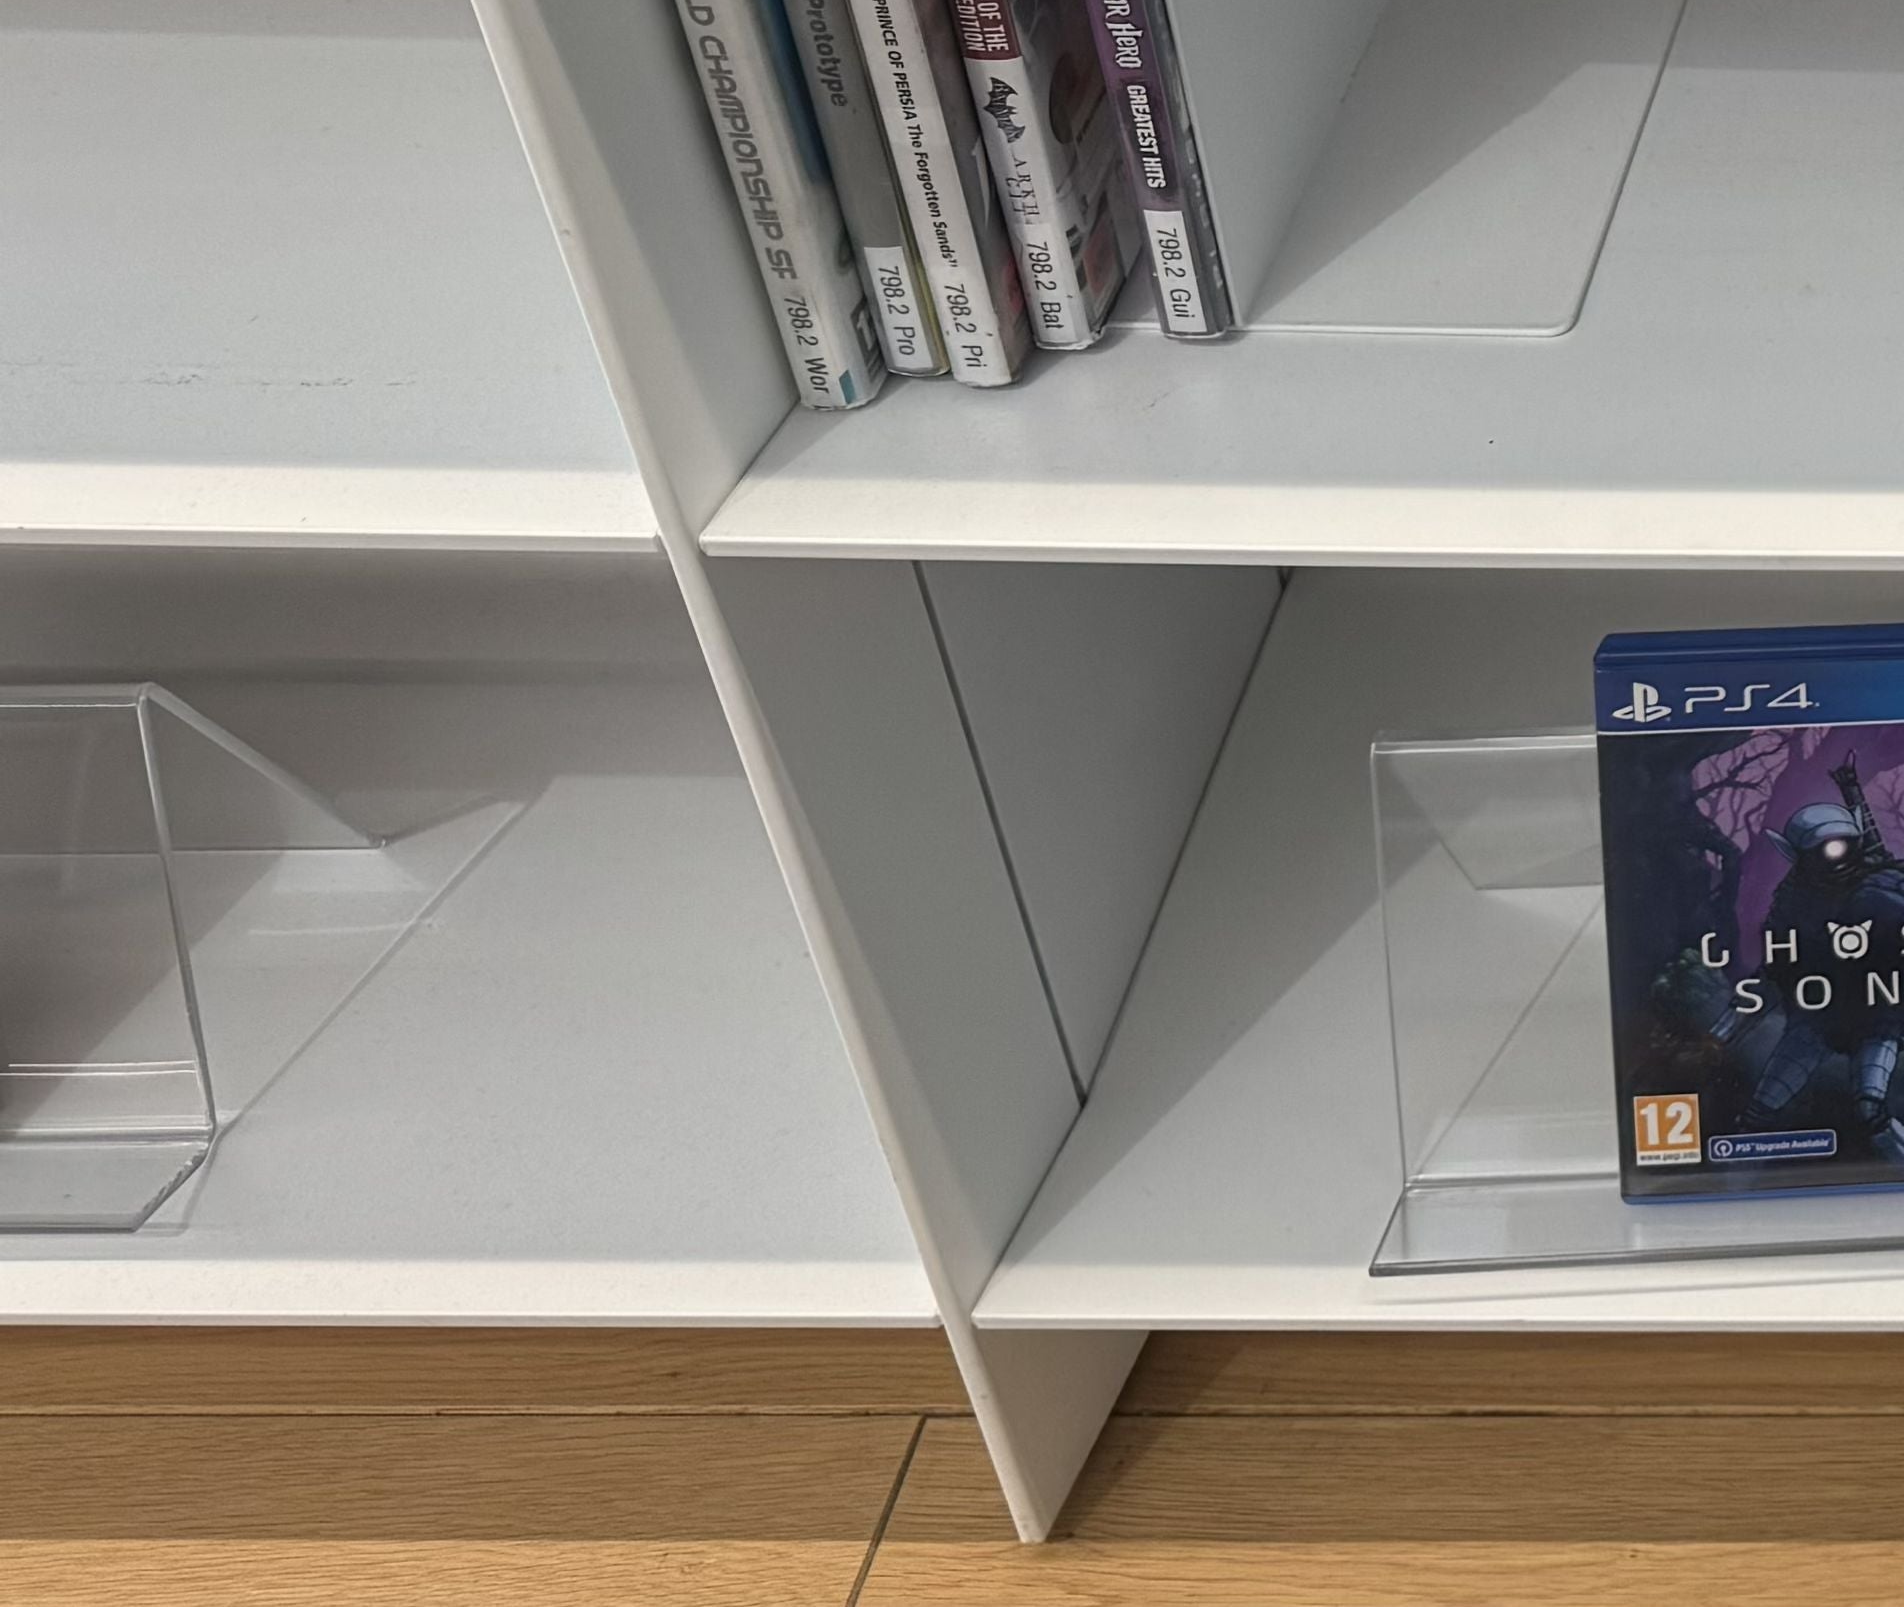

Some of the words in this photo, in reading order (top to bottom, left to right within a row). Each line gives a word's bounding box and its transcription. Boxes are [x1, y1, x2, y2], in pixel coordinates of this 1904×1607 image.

[978, 3, 1000, 19] OF
[983, 24, 1009, 51] THE
[887, 50, 902, 70] OF
[894, 72, 917, 121] PERSIA
[698, 34, 784, 241] CHAMPIONSHIP
[907, 124, 923, 148] The
[1127, 85, 1157, 154] GREATEST
[1143, 155, 1167, 189] HITS
[913, 151, 939, 218] Forgotten
[1157, 228, 1186, 278] 798.2
[1169, 288, 1196, 317] Gui
[1684, 684, 1812, 713] PS4
[1639, 1102, 1693, 1145] 12
